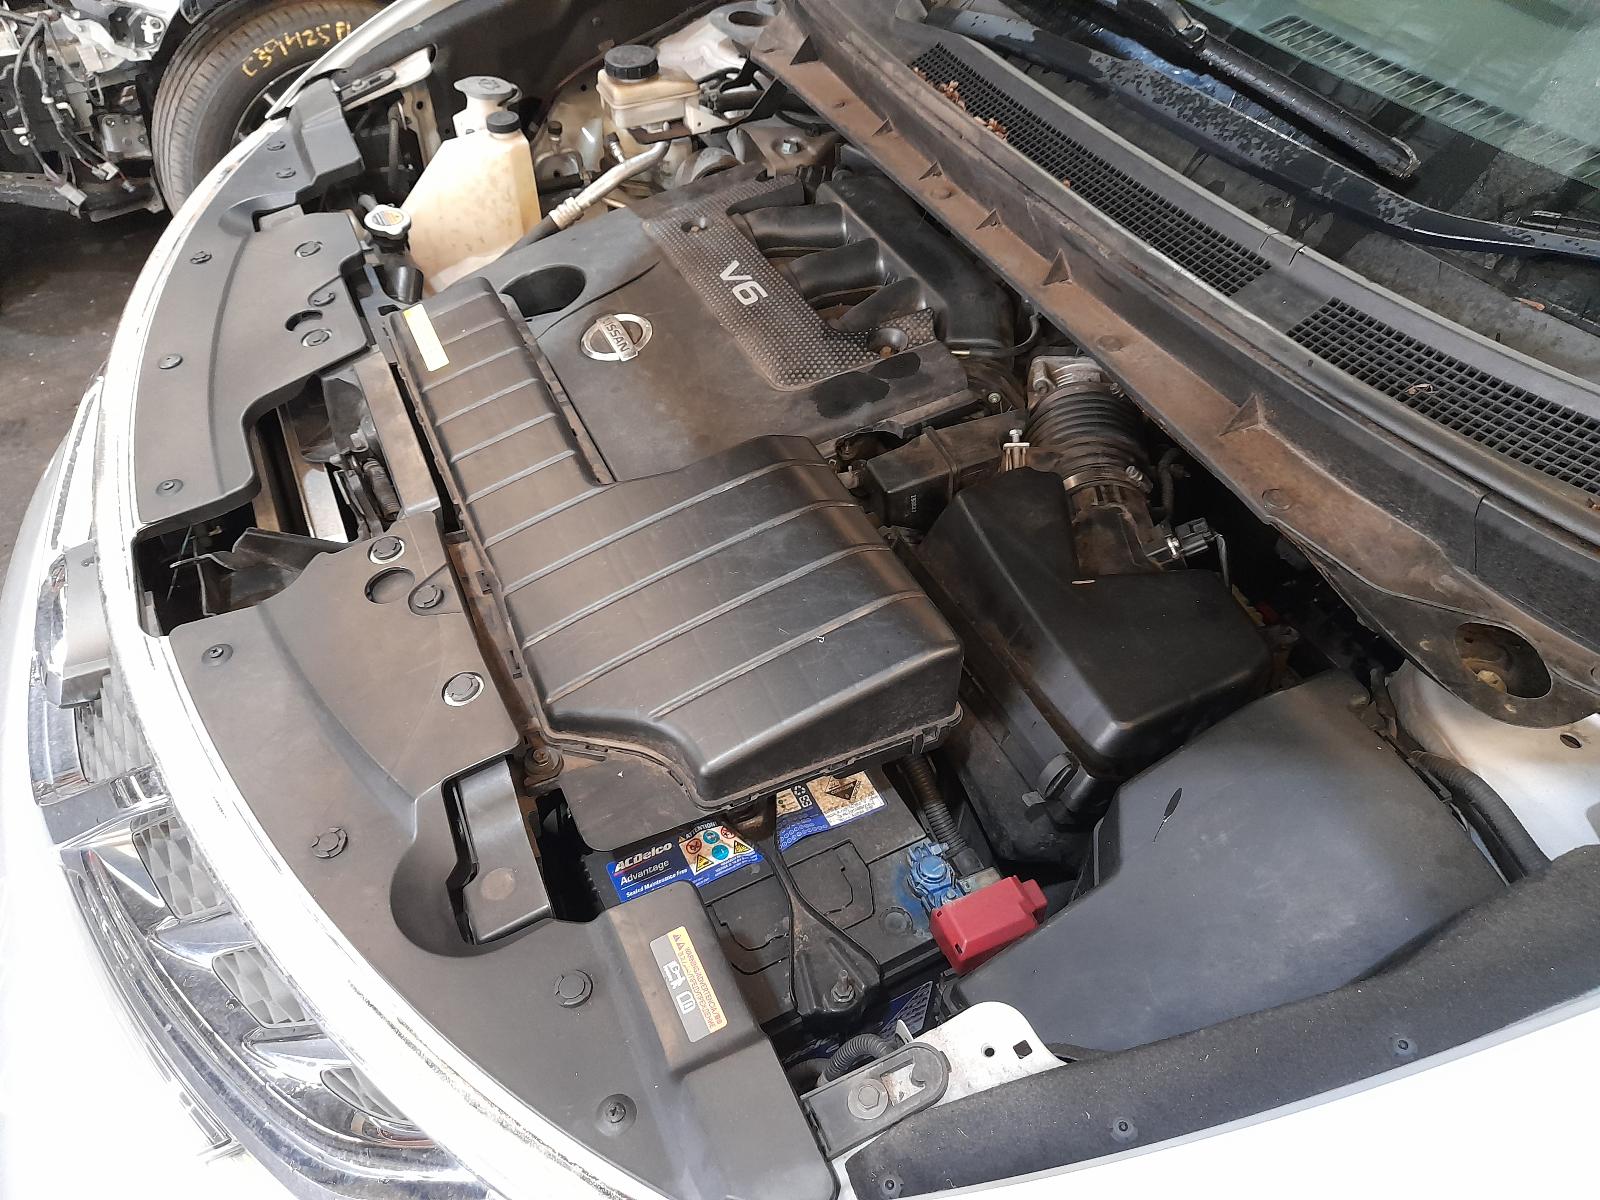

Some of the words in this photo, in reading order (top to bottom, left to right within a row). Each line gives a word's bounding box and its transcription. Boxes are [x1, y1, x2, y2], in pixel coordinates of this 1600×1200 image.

[719, 259, 769, 306] V6
[614, 842, 673, 873] ACDelco
[620, 860, 669, 886] Advantage
[625, 887, 644, 898] Sealed
[644, 873, 676, 890] Maintenance
